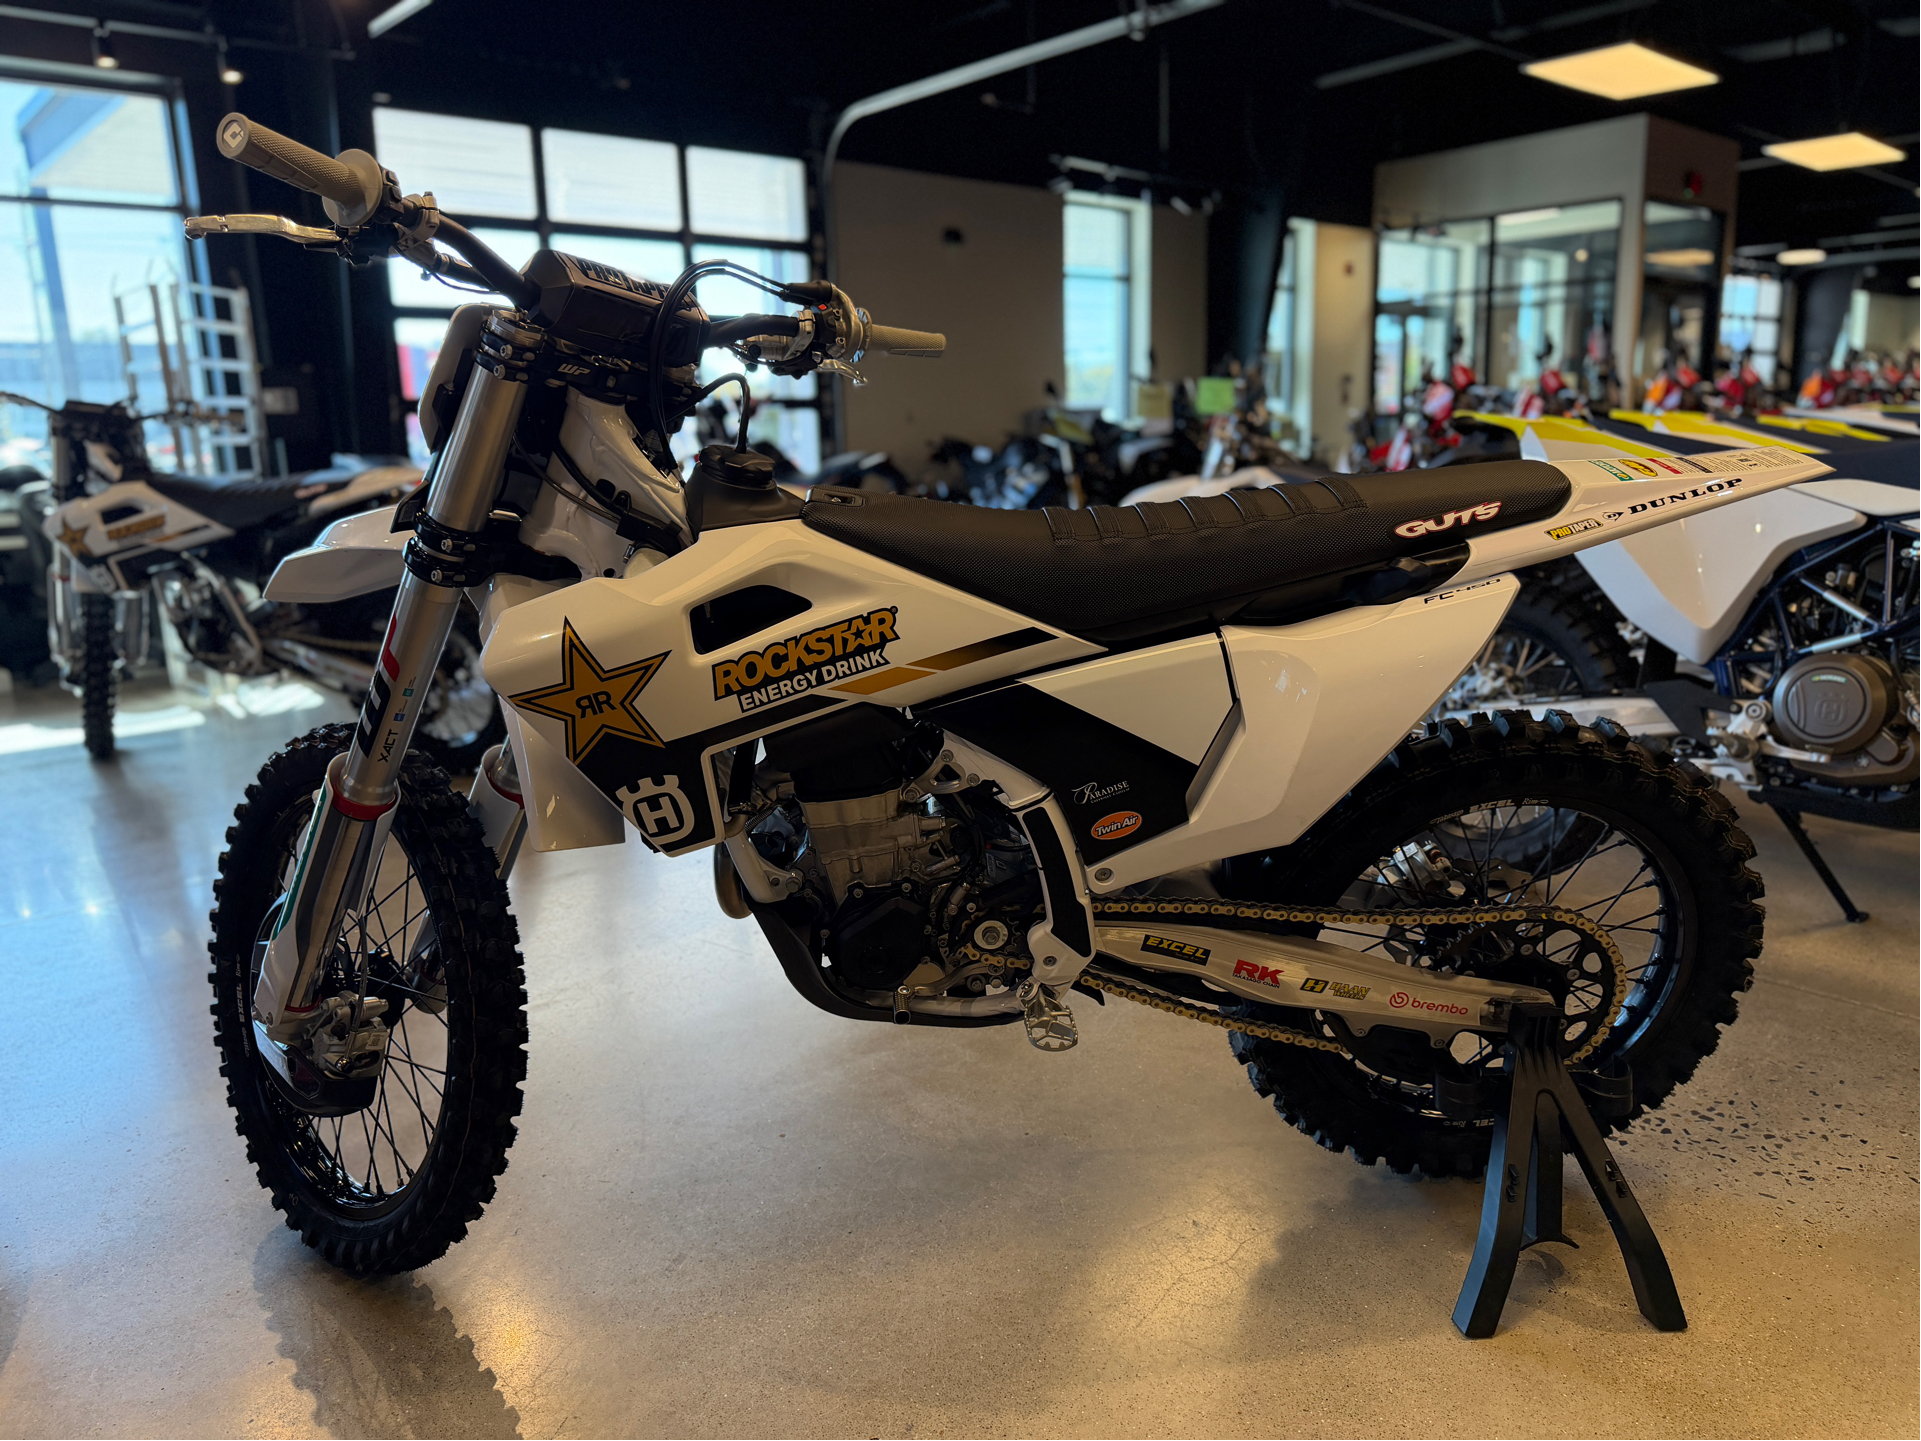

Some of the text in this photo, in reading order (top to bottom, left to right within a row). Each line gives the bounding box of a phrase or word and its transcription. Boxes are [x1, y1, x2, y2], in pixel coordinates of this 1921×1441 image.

[557, 363, 591, 376] WP
[1627, 477, 1743, 515] DUNLOP
[1394, 501, 1503, 539] GUTS
[1549, 519, 1601, 540] PROTAPER
[713, 609, 898, 698] ROCKSTAR
[740, 648, 886, 711] ENERGY DRINK
[377, 728, 399, 763] XACT
[1070, 781, 1130, 805] PARADISE
[1468, 799, 1516, 813] EXCEL
[1095, 814, 1139, 837] Twin Air
[1145, 936, 1207, 959] EXCEL
[1232, 959, 1285, 986] RK
[1329, 981, 1372, 996] HAAN
[1410, 997, 1469, 1015] brembo
